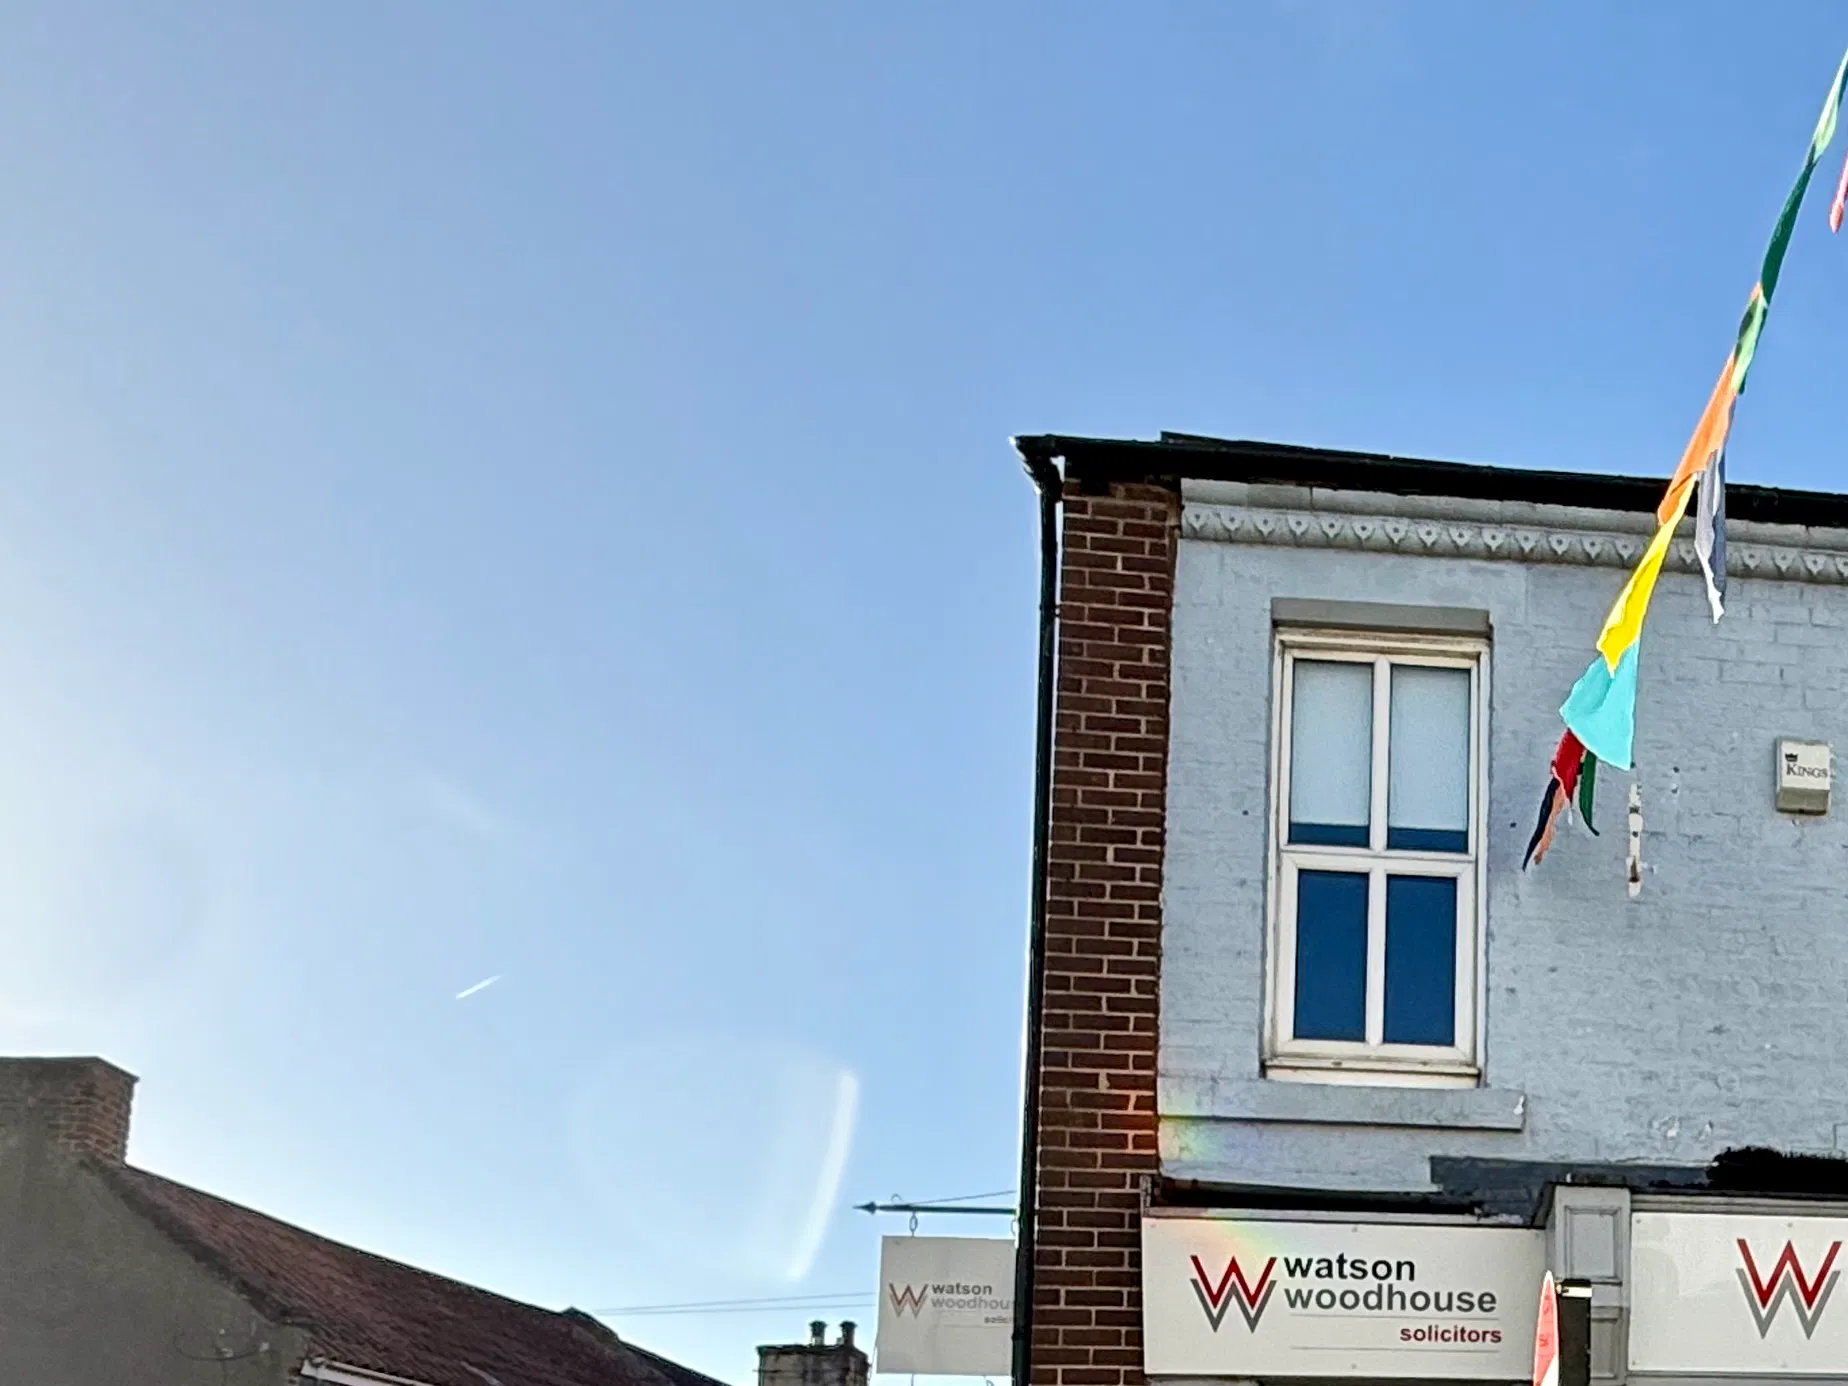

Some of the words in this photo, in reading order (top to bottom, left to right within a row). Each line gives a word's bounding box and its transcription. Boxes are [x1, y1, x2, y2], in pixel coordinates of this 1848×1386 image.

[1283, 1253, 1416, 1281] watson
[931, 1283, 993, 1296] watson
[1285, 1284, 1497, 1313] woodhouse
[931, 1297, 1012, 1310] woodhou
[1400, 1324, 1503, 1344] solicitors
